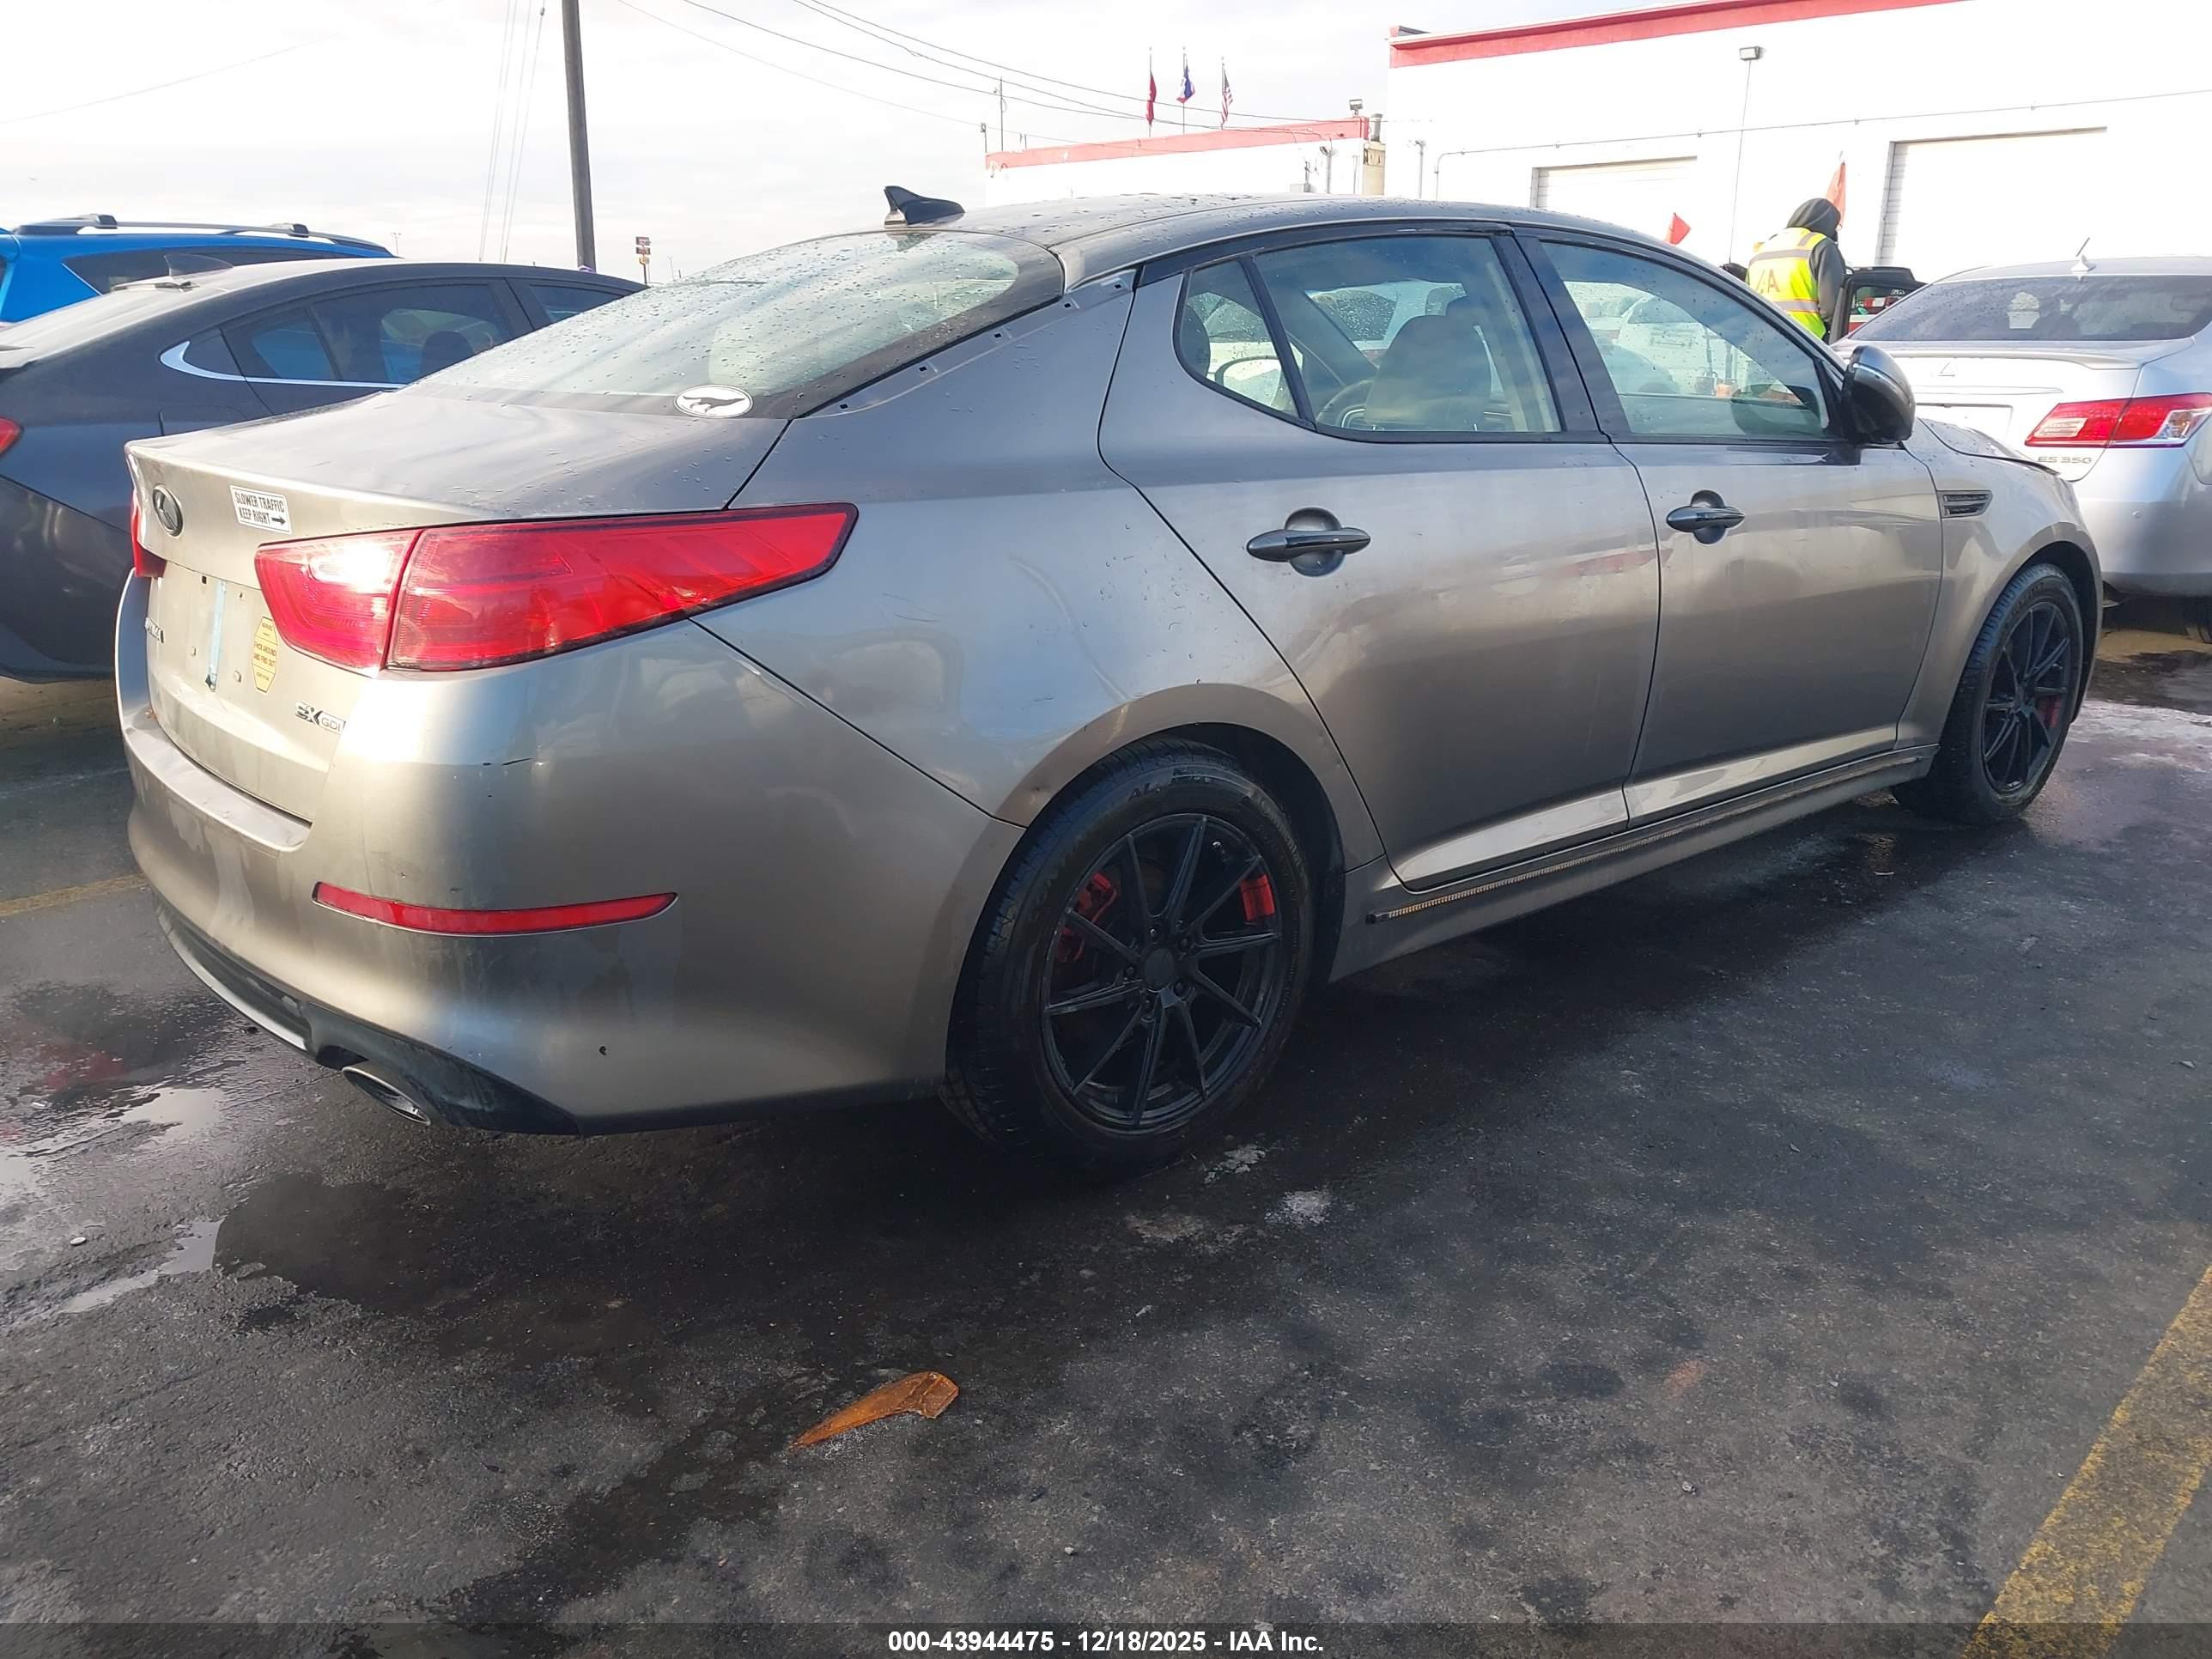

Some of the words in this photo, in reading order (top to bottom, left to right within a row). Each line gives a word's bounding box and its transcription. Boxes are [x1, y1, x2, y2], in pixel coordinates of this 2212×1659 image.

[2061, 456, 2093, 465] 350
[234, 491, 259, 508] SLOWER
[258, 496, 285, 513] TRAFFIC
[238, 507, 252, 520] KEEP
[252, 509, 270, 526] RIGHT
[321, 716, 341, 732] GDI
